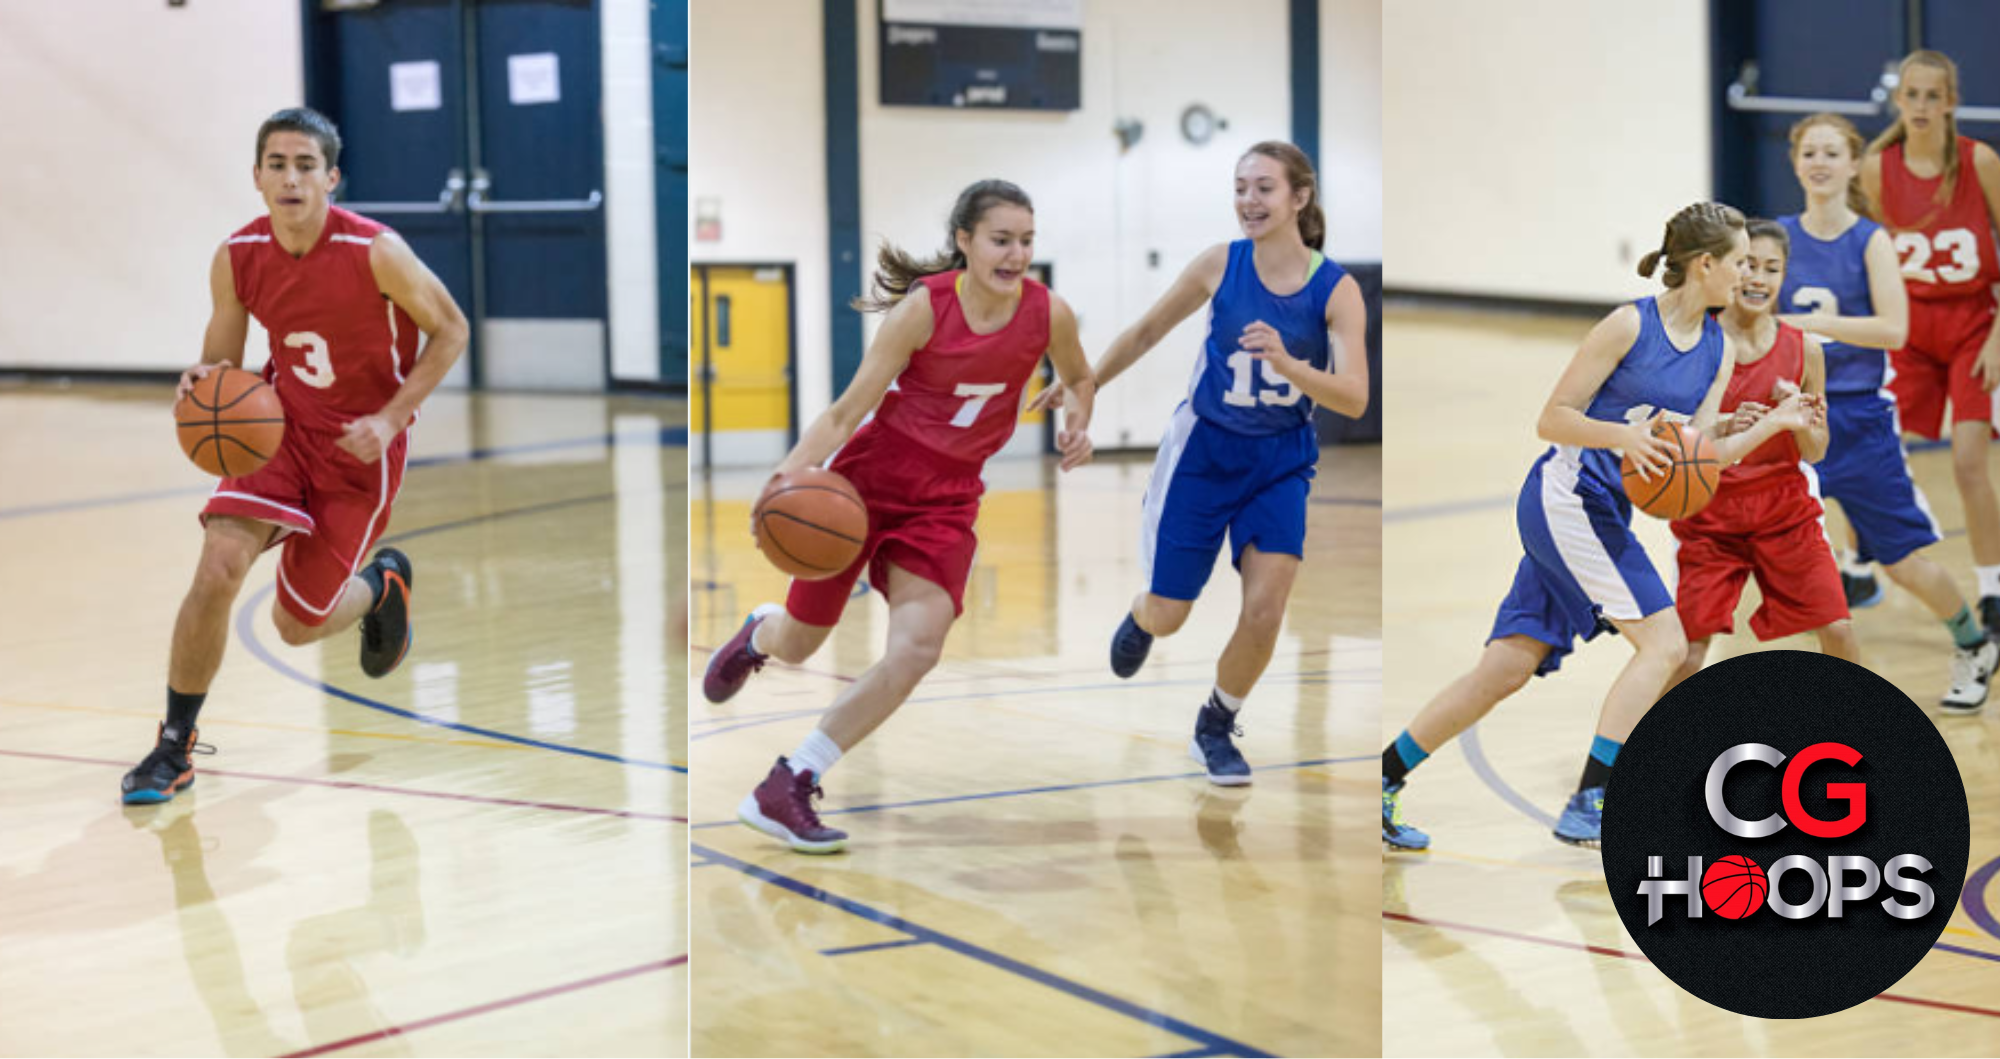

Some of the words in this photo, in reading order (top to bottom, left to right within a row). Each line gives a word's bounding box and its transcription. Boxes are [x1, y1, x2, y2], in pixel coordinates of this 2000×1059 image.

[1895, 227, 1981, 283] 23
[284, 331, 336, 389] 3
[949, 383, 1007, 427] 7
